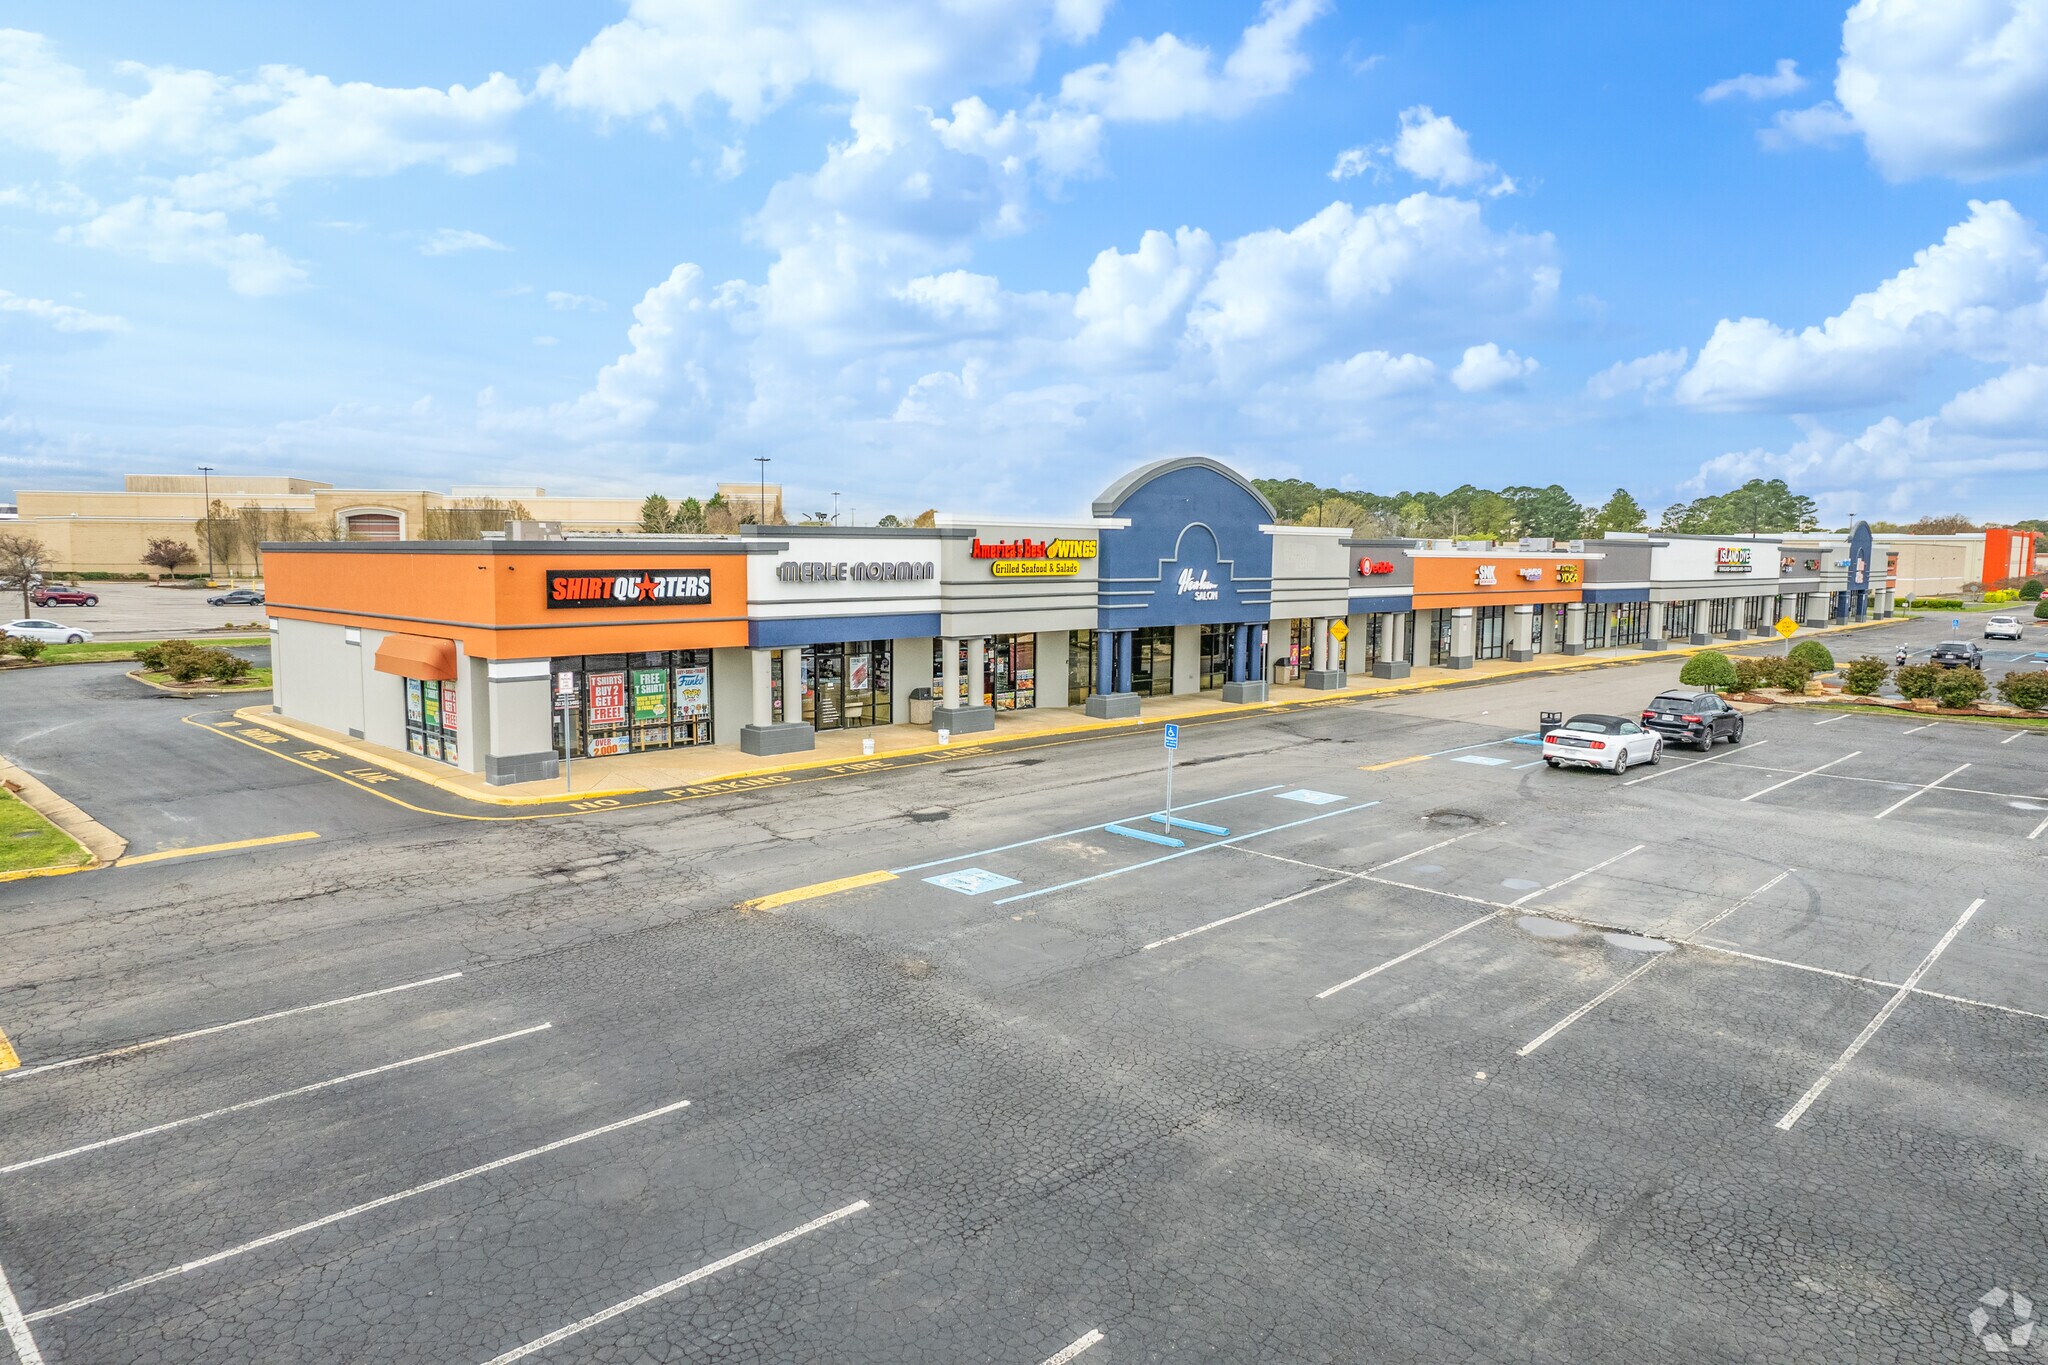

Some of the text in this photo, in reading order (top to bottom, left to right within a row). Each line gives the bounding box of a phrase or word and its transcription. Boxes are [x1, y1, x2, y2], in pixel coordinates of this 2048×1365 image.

[971, 538, 1097, 559] America's Best WINGS
[780, 561, 935, 582] MERLE NORMAN
[995, 562, 1078, 574] Grilled Seafood & Salads
[1561, 573, 1578, 583] YOGA
[552, 574, 710, 601] SHIRT QURTERS
[1194, 591, 1218, 601] SALON
[597, 675, 622, 686] SHIRTS
[640, 673, 660, 685] FREE
[678, 674, 705, 687] Funko
[595, 685, 619, 697] BUY 2
[641, 683, 665, 694] SHIRT!
[595, 696, 619, 707] GET 1
[594, 707, 621, 720] FREE!
[595, 738, 612, 747] OVER
[568, 746, 994, 810] NO PARKING FIRE LANE
